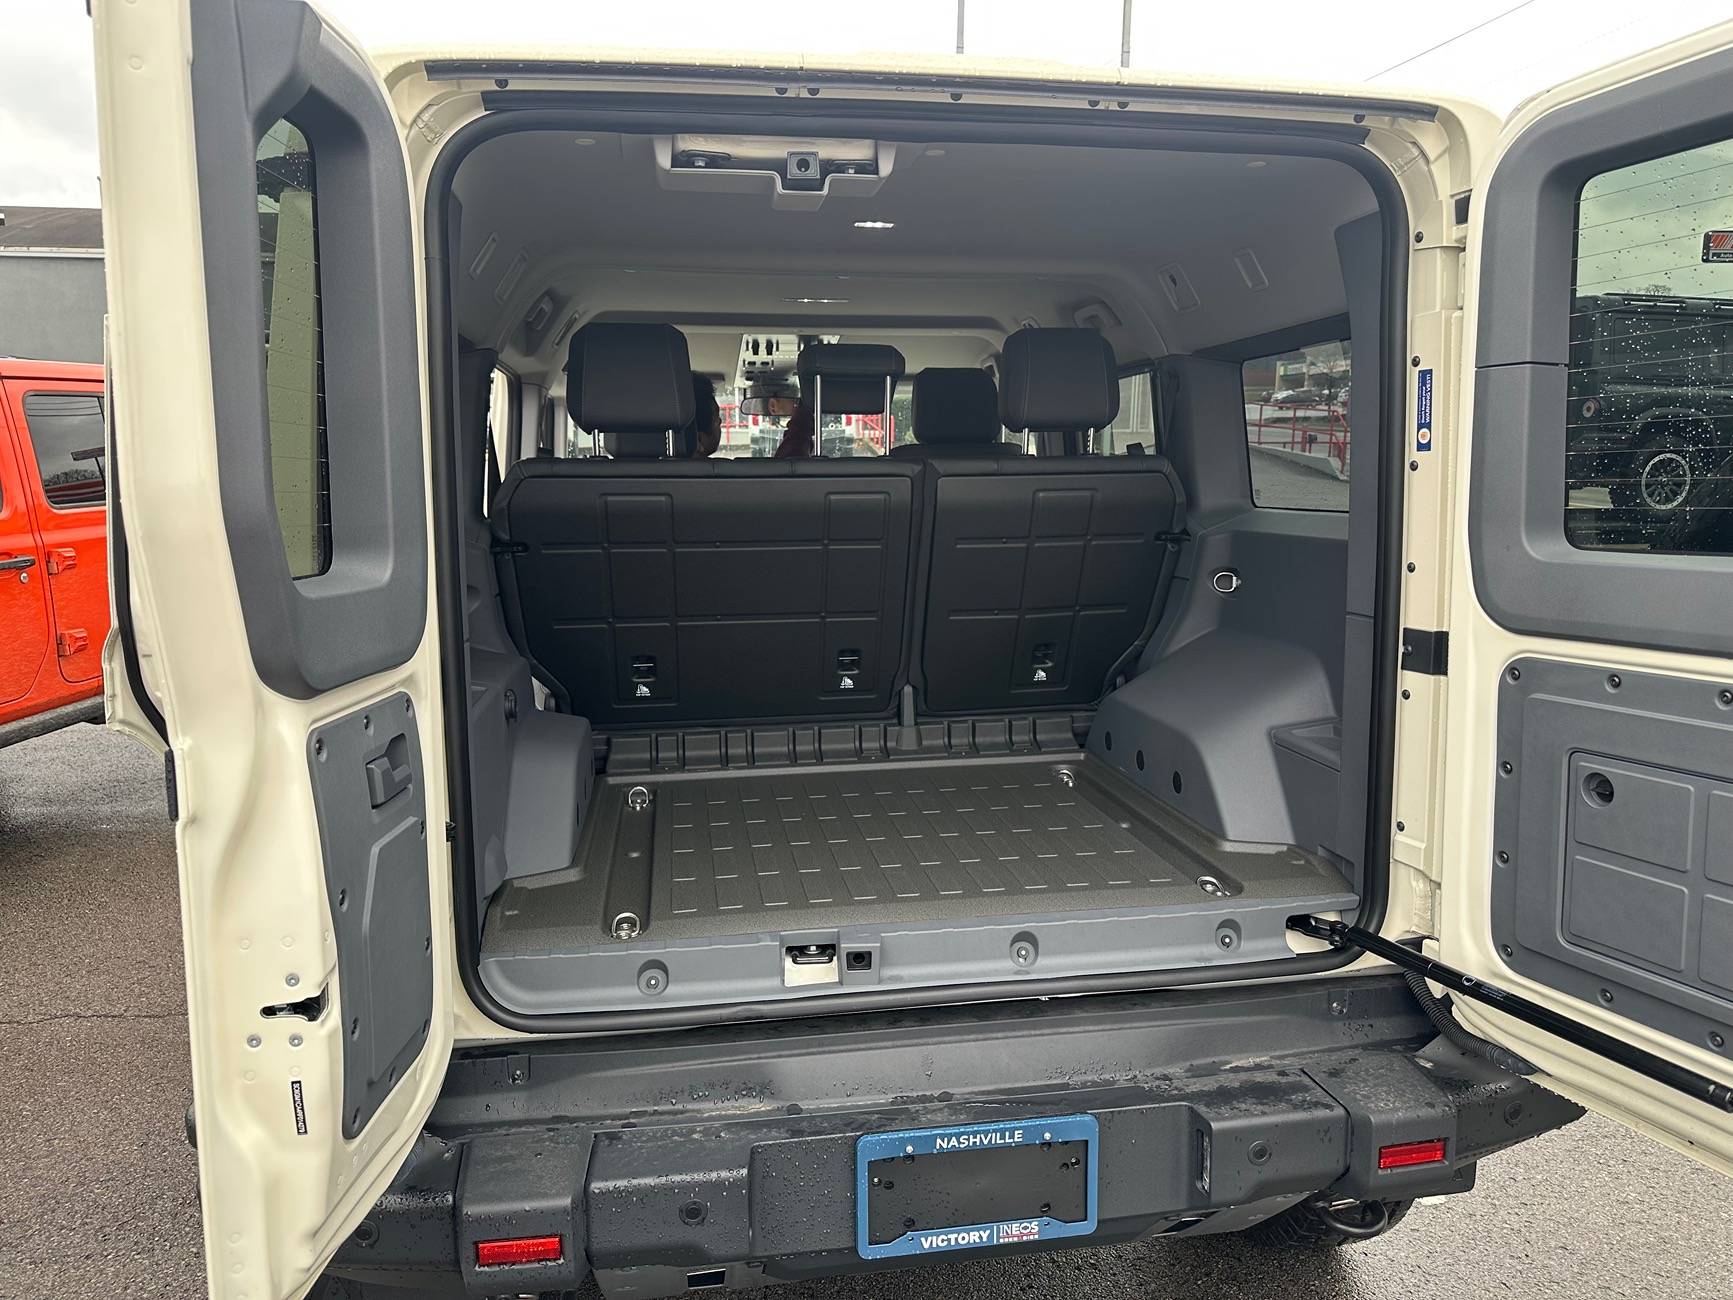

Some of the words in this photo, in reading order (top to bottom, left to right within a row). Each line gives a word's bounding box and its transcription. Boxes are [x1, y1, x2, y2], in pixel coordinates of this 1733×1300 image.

[936, 1130, 1024, 1149] NASHVILLE
[920, 1229, 991, 1249] VICTORY
[999, 1221, 1039, 1235] INEOS
